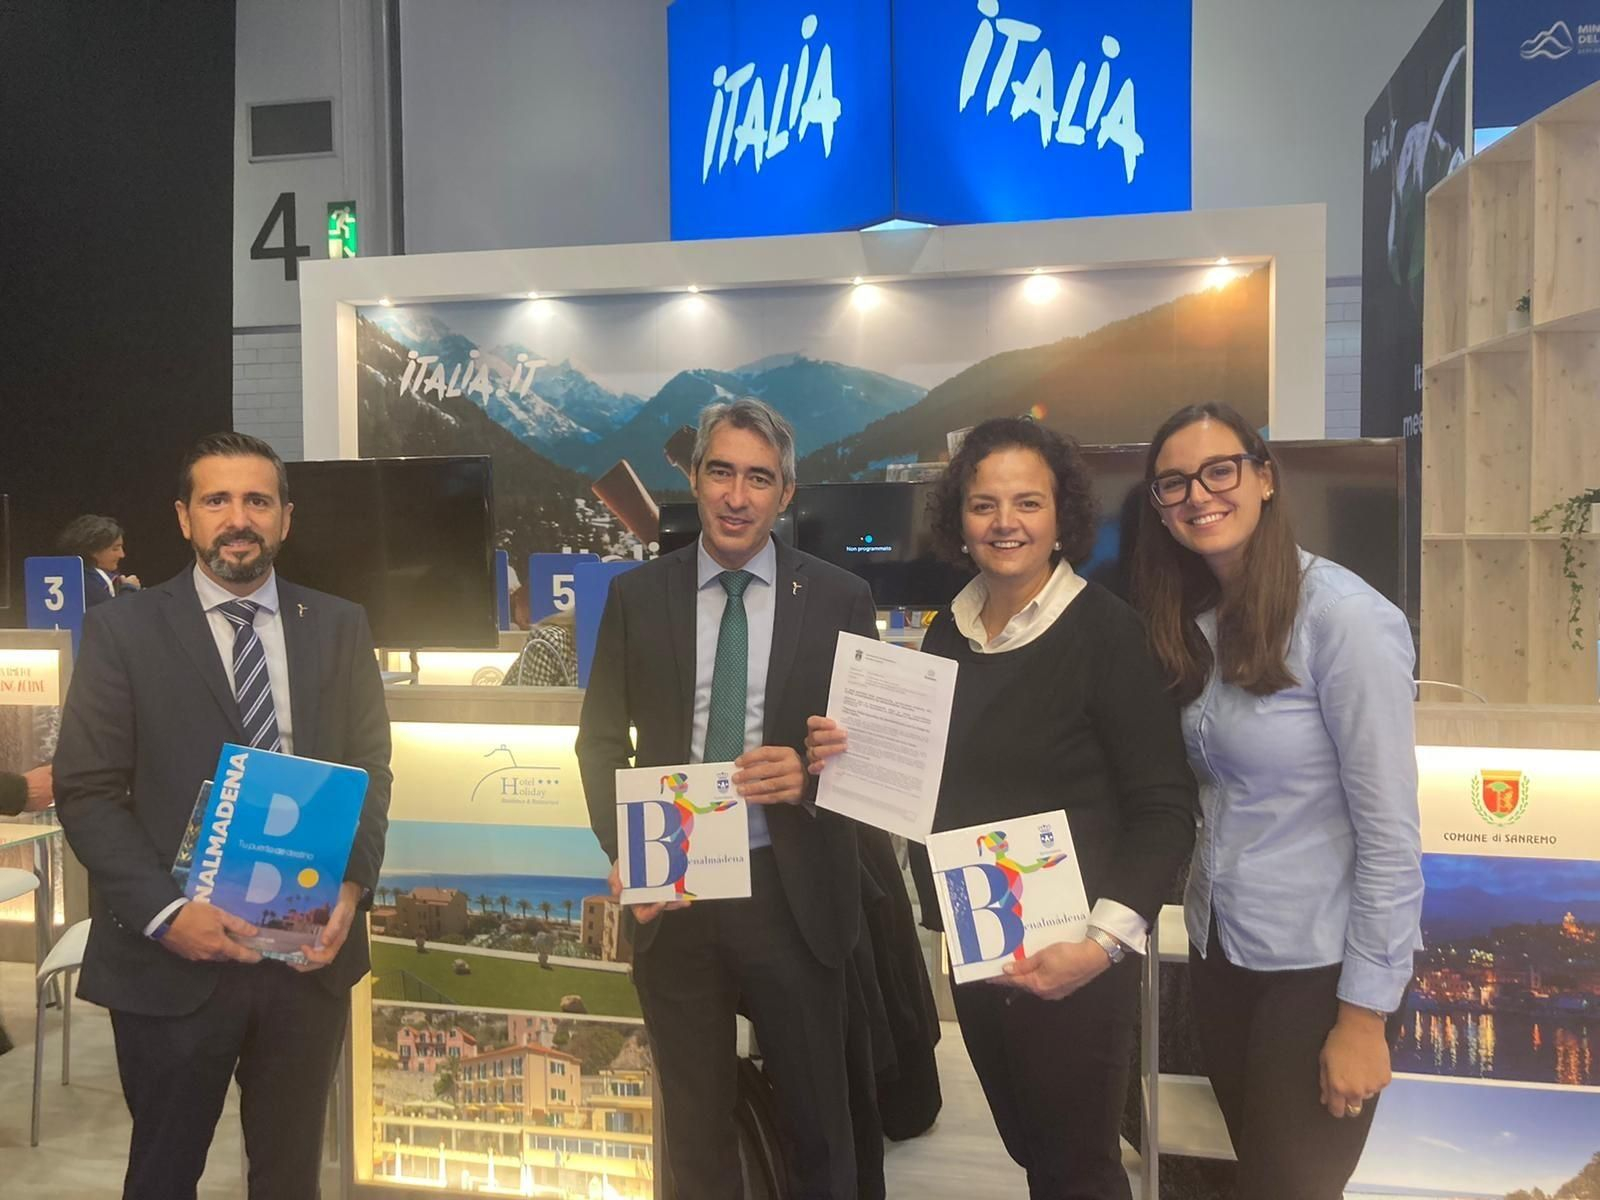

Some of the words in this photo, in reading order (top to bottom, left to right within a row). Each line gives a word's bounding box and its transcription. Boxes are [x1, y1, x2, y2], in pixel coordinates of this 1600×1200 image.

[250, 192, 310, 280] 4
[44, 576, 65, 611] 3
[552, 574, 576, 612] 5
[1443, 832, 1488, 843] COMUNE
[1492, 833, 1501, 843] di
[1505, 834, 1557, 845] SANREMO
